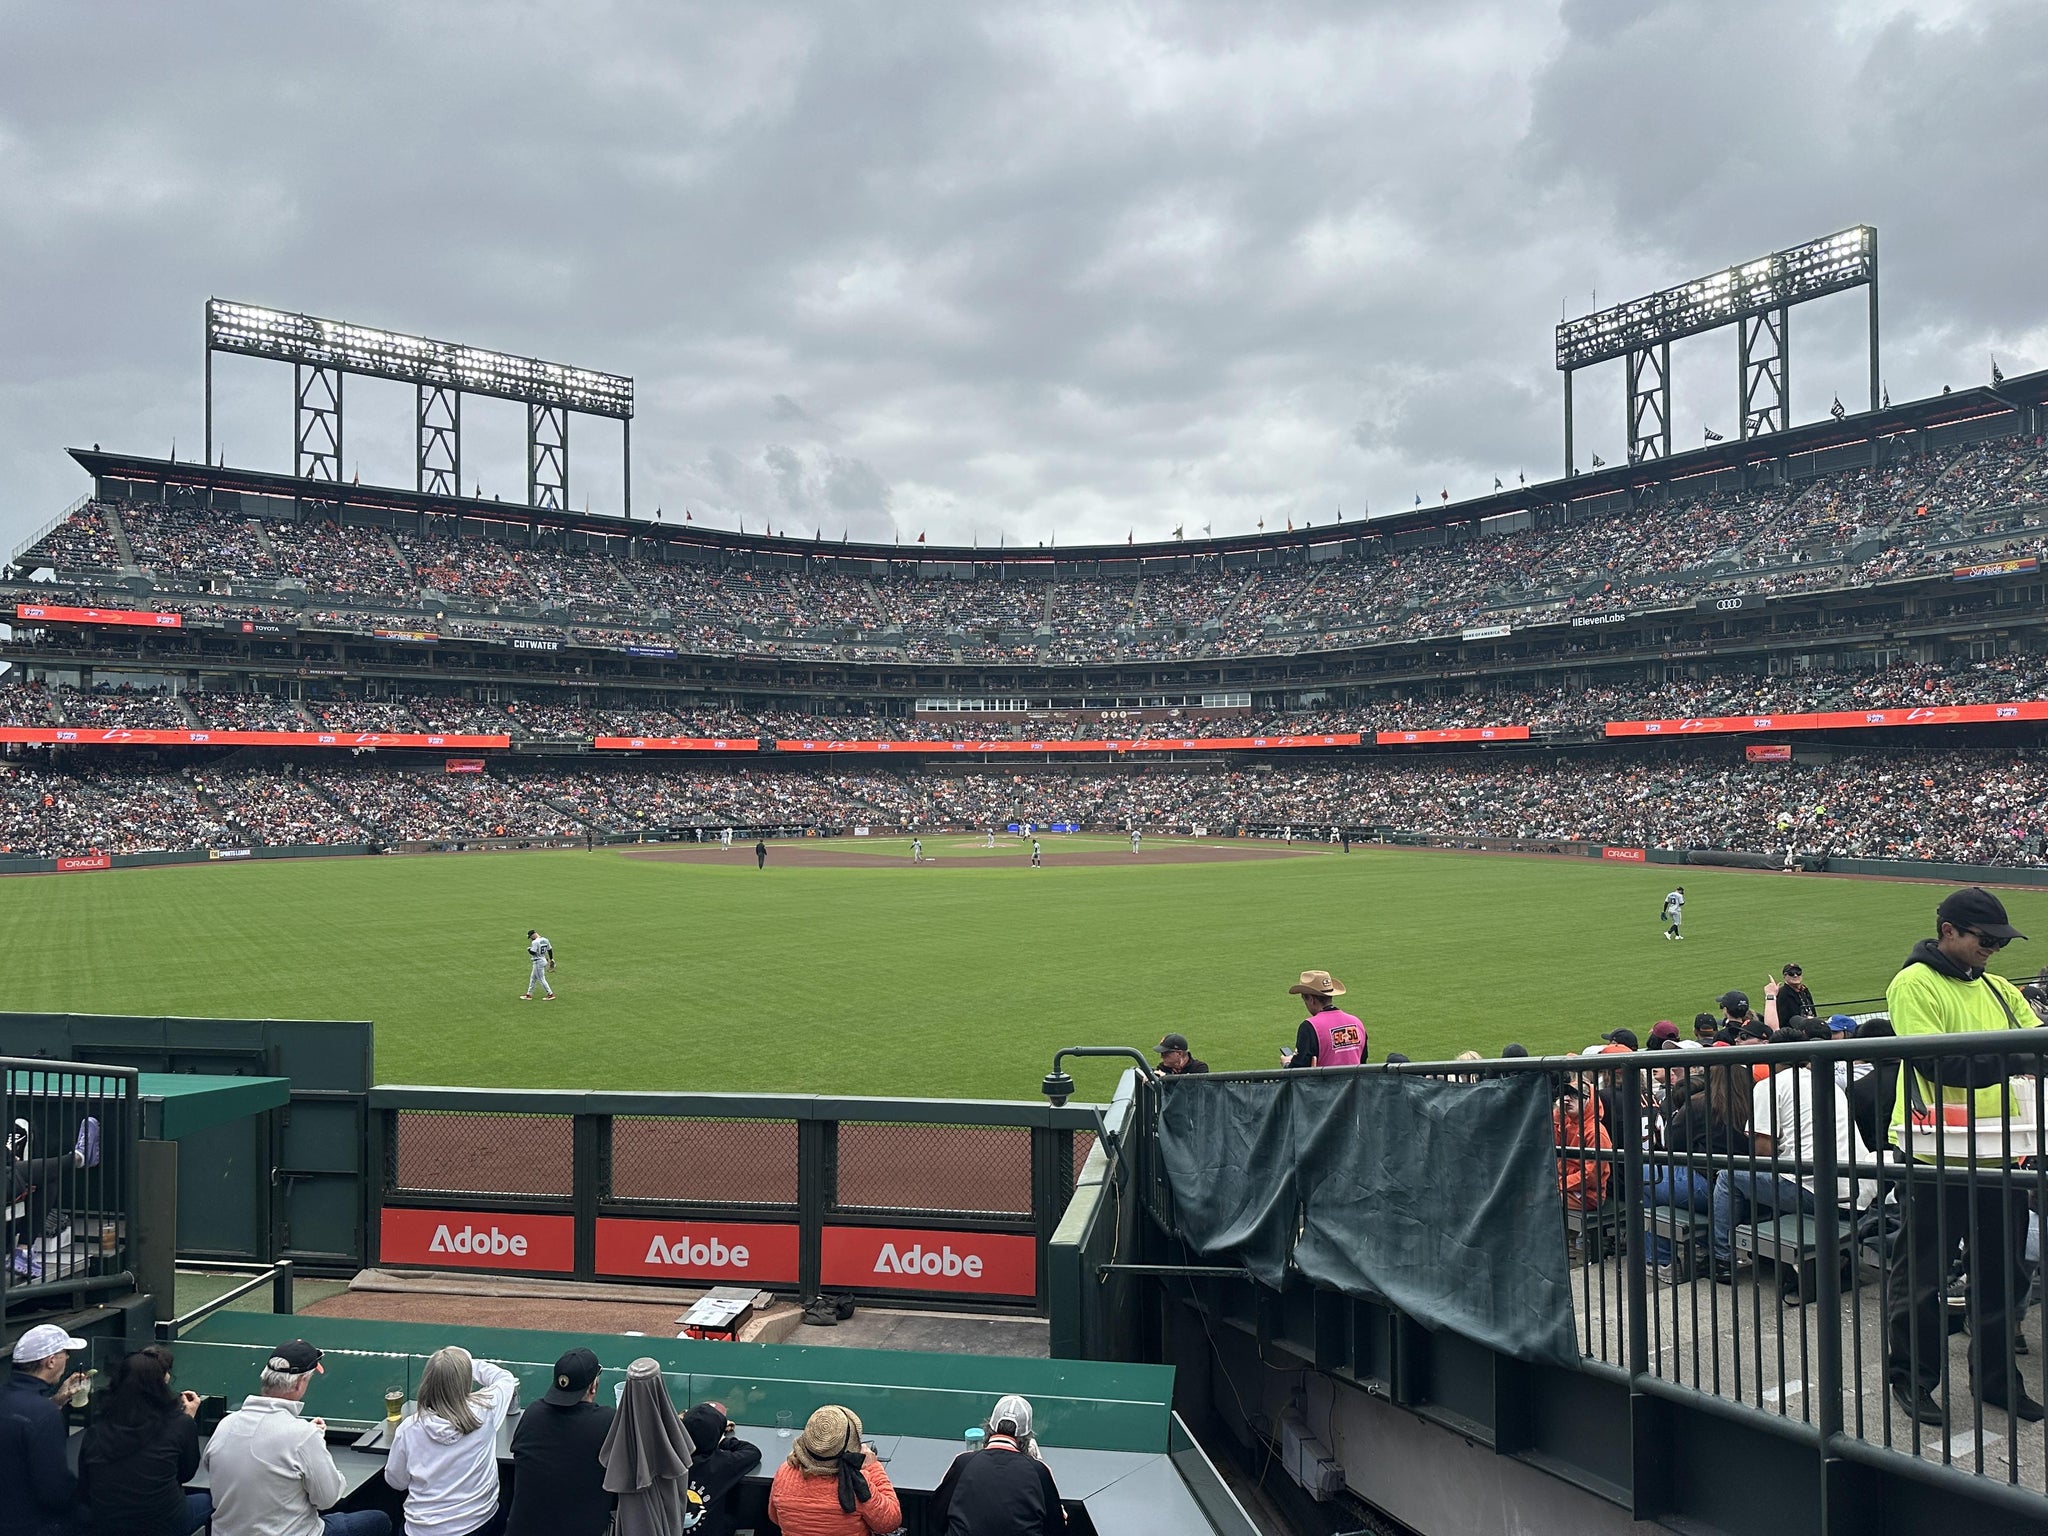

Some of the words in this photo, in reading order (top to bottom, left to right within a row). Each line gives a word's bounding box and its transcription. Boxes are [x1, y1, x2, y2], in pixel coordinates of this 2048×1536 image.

[1969, 564, 2002, 578] Surfside
[514, 640, 558, 650] CUTWATER
[1607, 850, 1639, 858] ORACLE
[64, 859, 104, 868] ORACLE
[429, 1225, 527, 1257] Adobe
[645, 1235, 749, 1268] Adobe
[873, 1243, 984, 1279] Adobe
